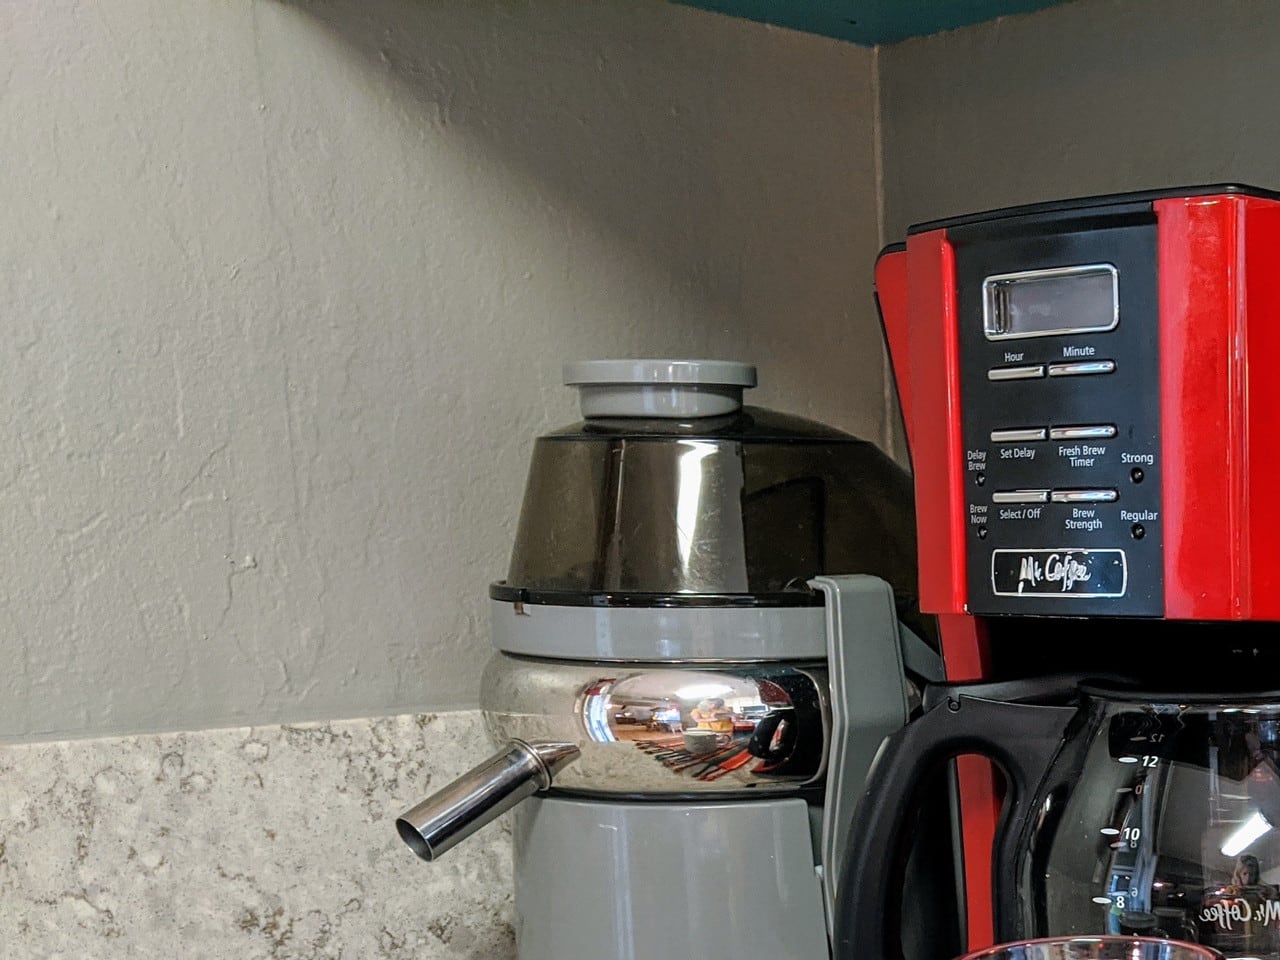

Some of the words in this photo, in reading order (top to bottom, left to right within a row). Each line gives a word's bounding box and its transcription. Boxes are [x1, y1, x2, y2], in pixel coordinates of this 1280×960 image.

[1004, 352, 1024, 362] Hour
[1063, 346, 1095, 357] Minute
[967, 449, 987, 461] Delay
[1000, 448, 1012, 459] Set
[1013, 447, 1036, 460] Delay
[1058, 446, 1080, 456] Fresh
[1082, 445, 1106, 455] Brew
[1069, 457, 1095, 467] Timer
[1121, 452, 1154, 465] Strong
[968, 462, 986, 471] Brew
[969, 504, 988, 513] Brew
[1000, 509, 1021, 519] Select
[1027, 508, 1041, 518] Off
[1072, 508, 1095, 518] Brew
[970, 515, 987, 524] Now
[1120, 509, 1158, 523] Regular
[1065, 519, 1103, 531] Strength
[1142, 755, 1159, 767] 12
[1123, 827, 1140, 840] 10
[1116, 895, 1125, 908] 8
